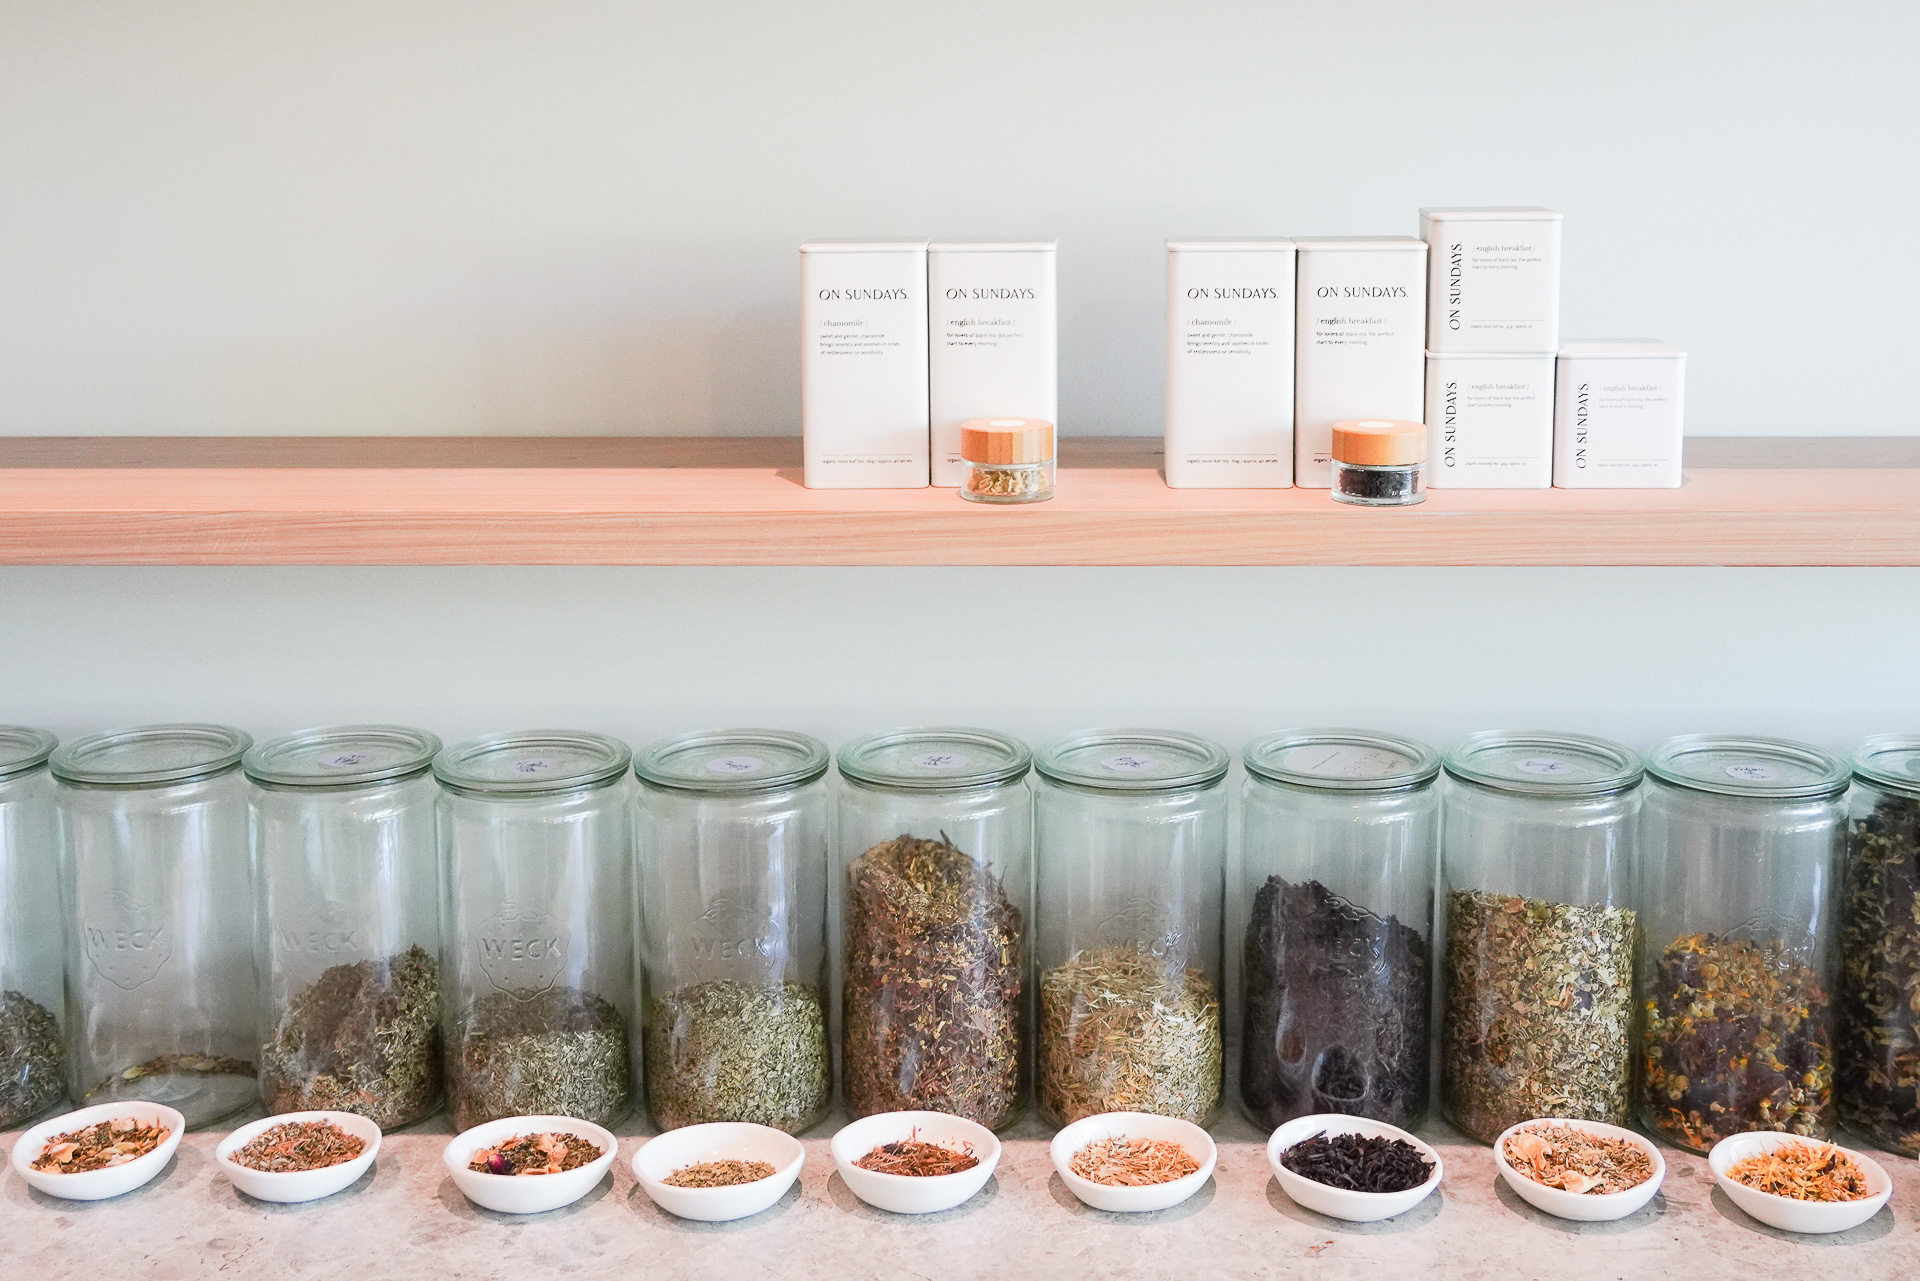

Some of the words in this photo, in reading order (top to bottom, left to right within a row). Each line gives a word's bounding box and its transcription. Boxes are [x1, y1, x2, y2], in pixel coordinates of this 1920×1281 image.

[1450, 242, 1462, 304] SUNDAYS.
[819, 289, 839, 300] ON
[845, 289, 909, 300] SUNDAYS.
[947, 289, 967, 299] ON
[973, 289, 1036, 299] SUNDAYS.
[1188, 288, 1209, 299] ON
[1214, 288, 1279, 299] SUNDAYS.
[1318, 287, 1338, 298] ON
[1344, 287, 1409, 298] SUNDAYS.
[1449, 310, 1460, 330] ON
[1445, 380, 1457, 442] SUNDAYS.
[1577, 382, 1588, 444] SUNDAYS.
[1444, 447, 1455, 467] ON
[1576, 449, 1586, 468] ON
[88, 927, 164, 950] WECK
[690, 937, 770, 960] WECK
[482, 937, 561, 961] WECK
